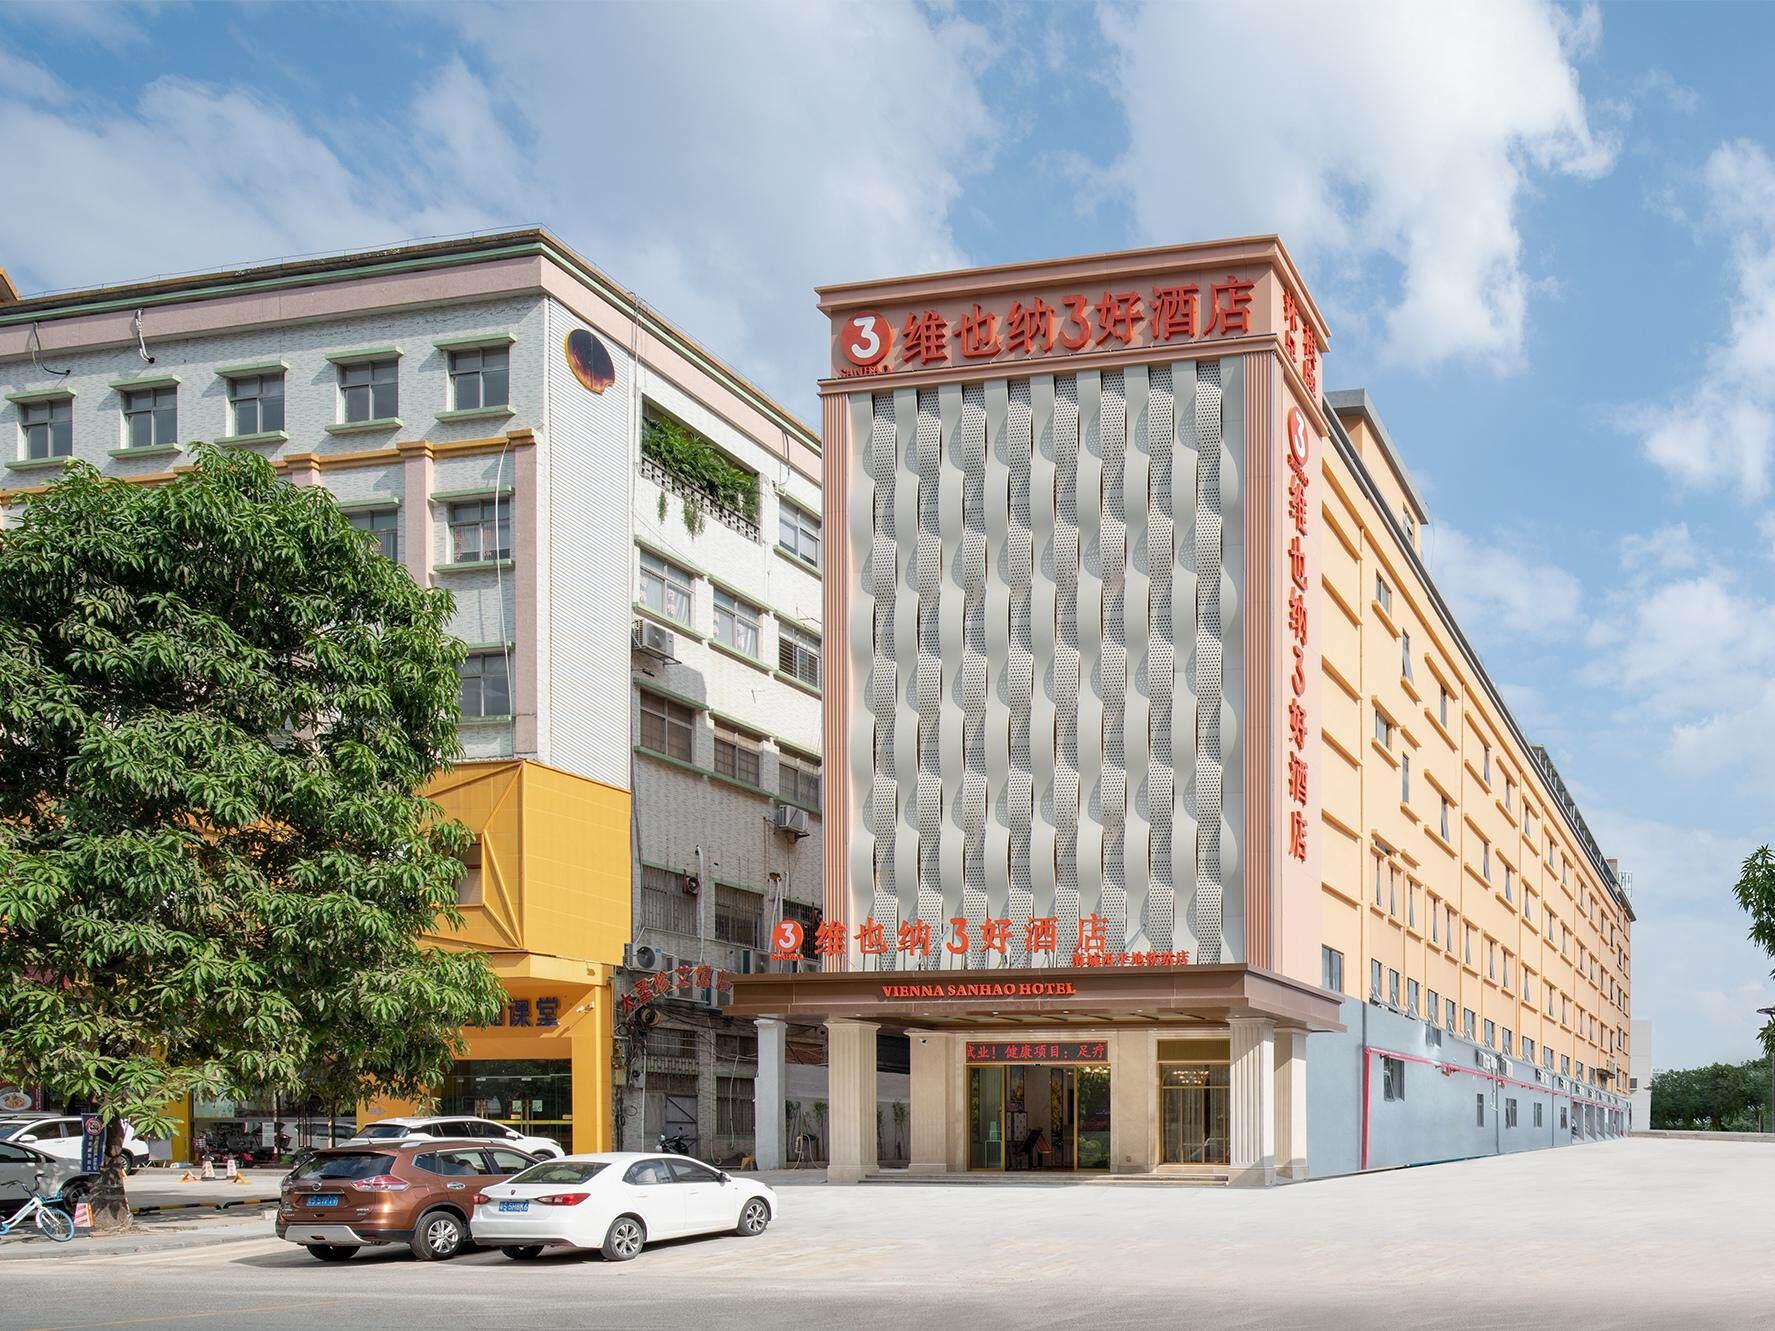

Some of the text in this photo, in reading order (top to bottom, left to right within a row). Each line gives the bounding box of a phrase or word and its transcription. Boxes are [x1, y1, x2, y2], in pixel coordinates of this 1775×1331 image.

[851, 316, 880, 359] 3
[902, 275, 1256, 366] 维也纳3好酒店
[779, 923, 796, 949] 3
[815, 914, 1109, 956] 维也纳3好酒店
[882, 982, 1076, 998] VIENNA SANHAO HOTEL
